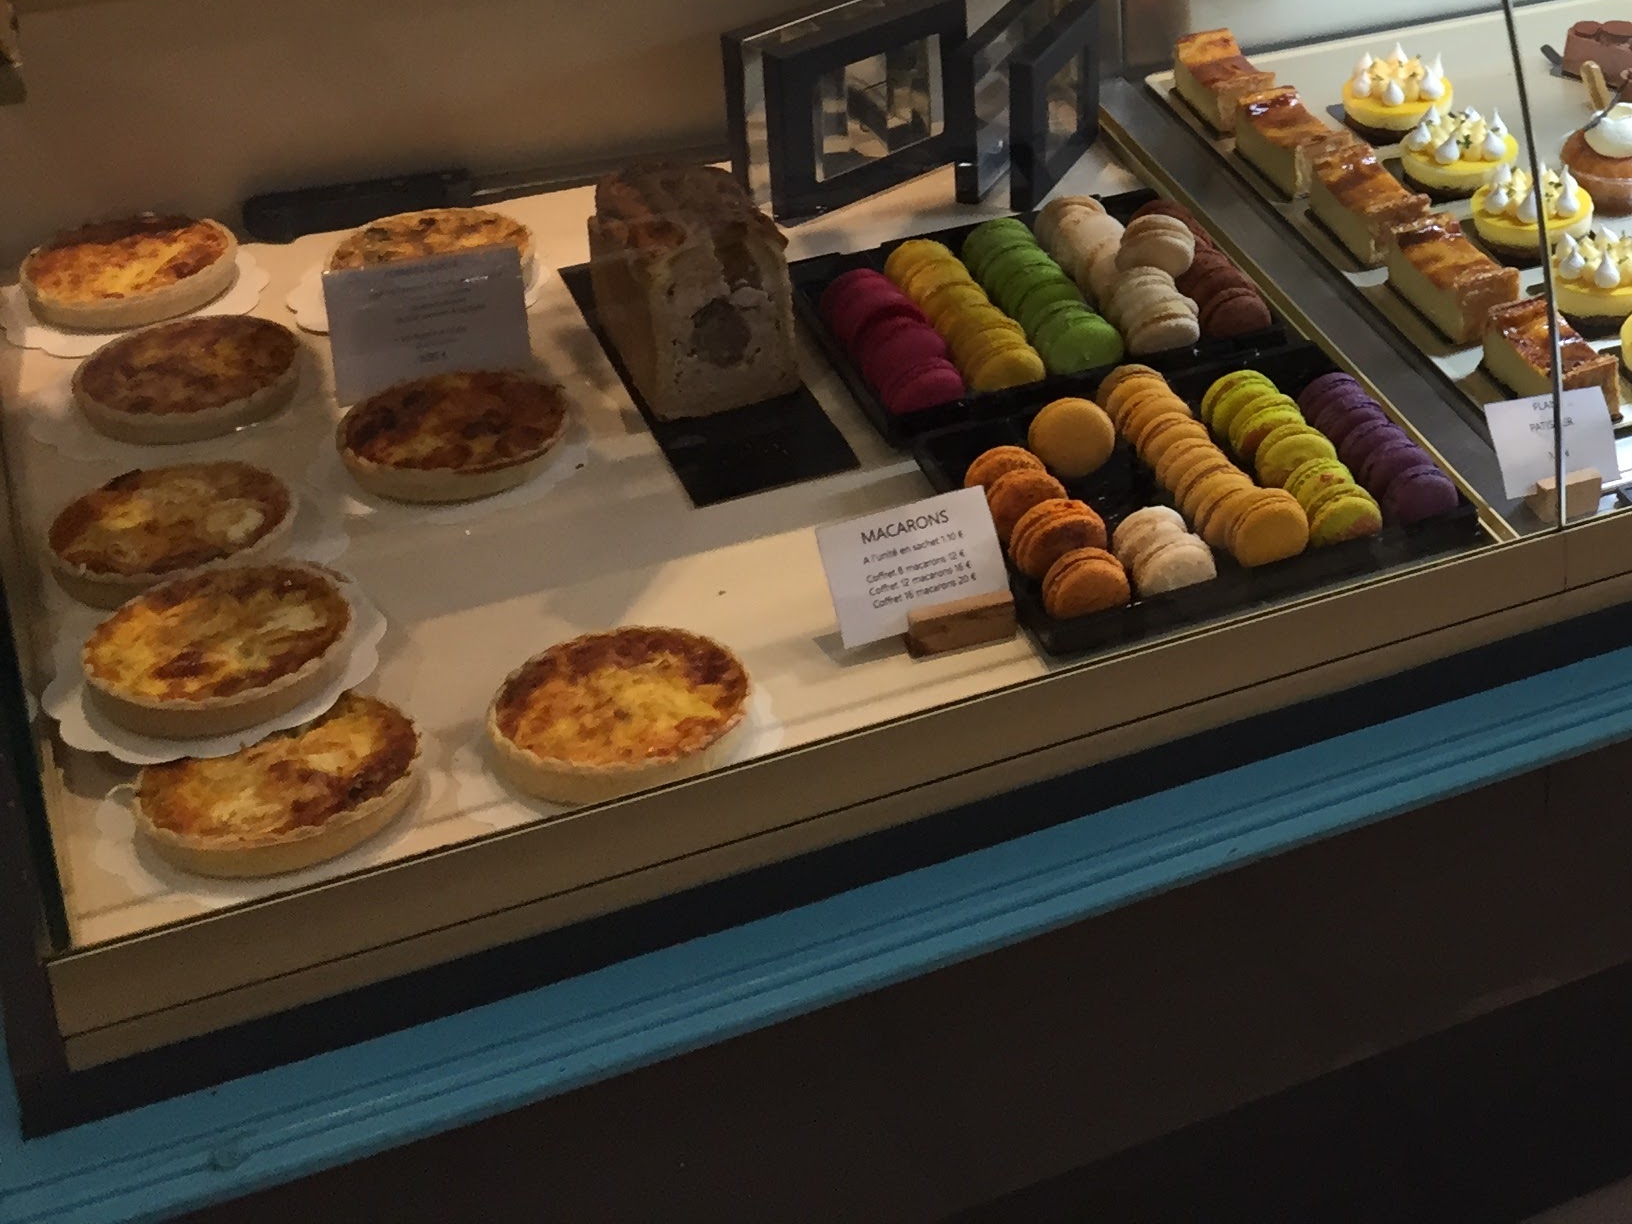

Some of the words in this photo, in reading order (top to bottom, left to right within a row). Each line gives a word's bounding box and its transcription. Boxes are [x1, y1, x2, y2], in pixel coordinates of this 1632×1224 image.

[1528, 416, 1575, 432] PATISER
[860, 509, 950, 545] MACARONS
[863, 554, 871, 565] A
[872, 548, 898, 562] l'unité
[900, 546, 911, 556] en
[913, 537, 940, 553] sachet
[866, 569, 898, 585] Coffret
[905, 556, 947, 575] macarons
[869, 582, 899, 597] Coffret
[900, 578, 910, 589] 12
[912, 566, 954, 586] macarons
[873, 594, 904, 610] Coffret
[916, 578, 957, 598] macarons
[958, 574, 969, 586] 20
